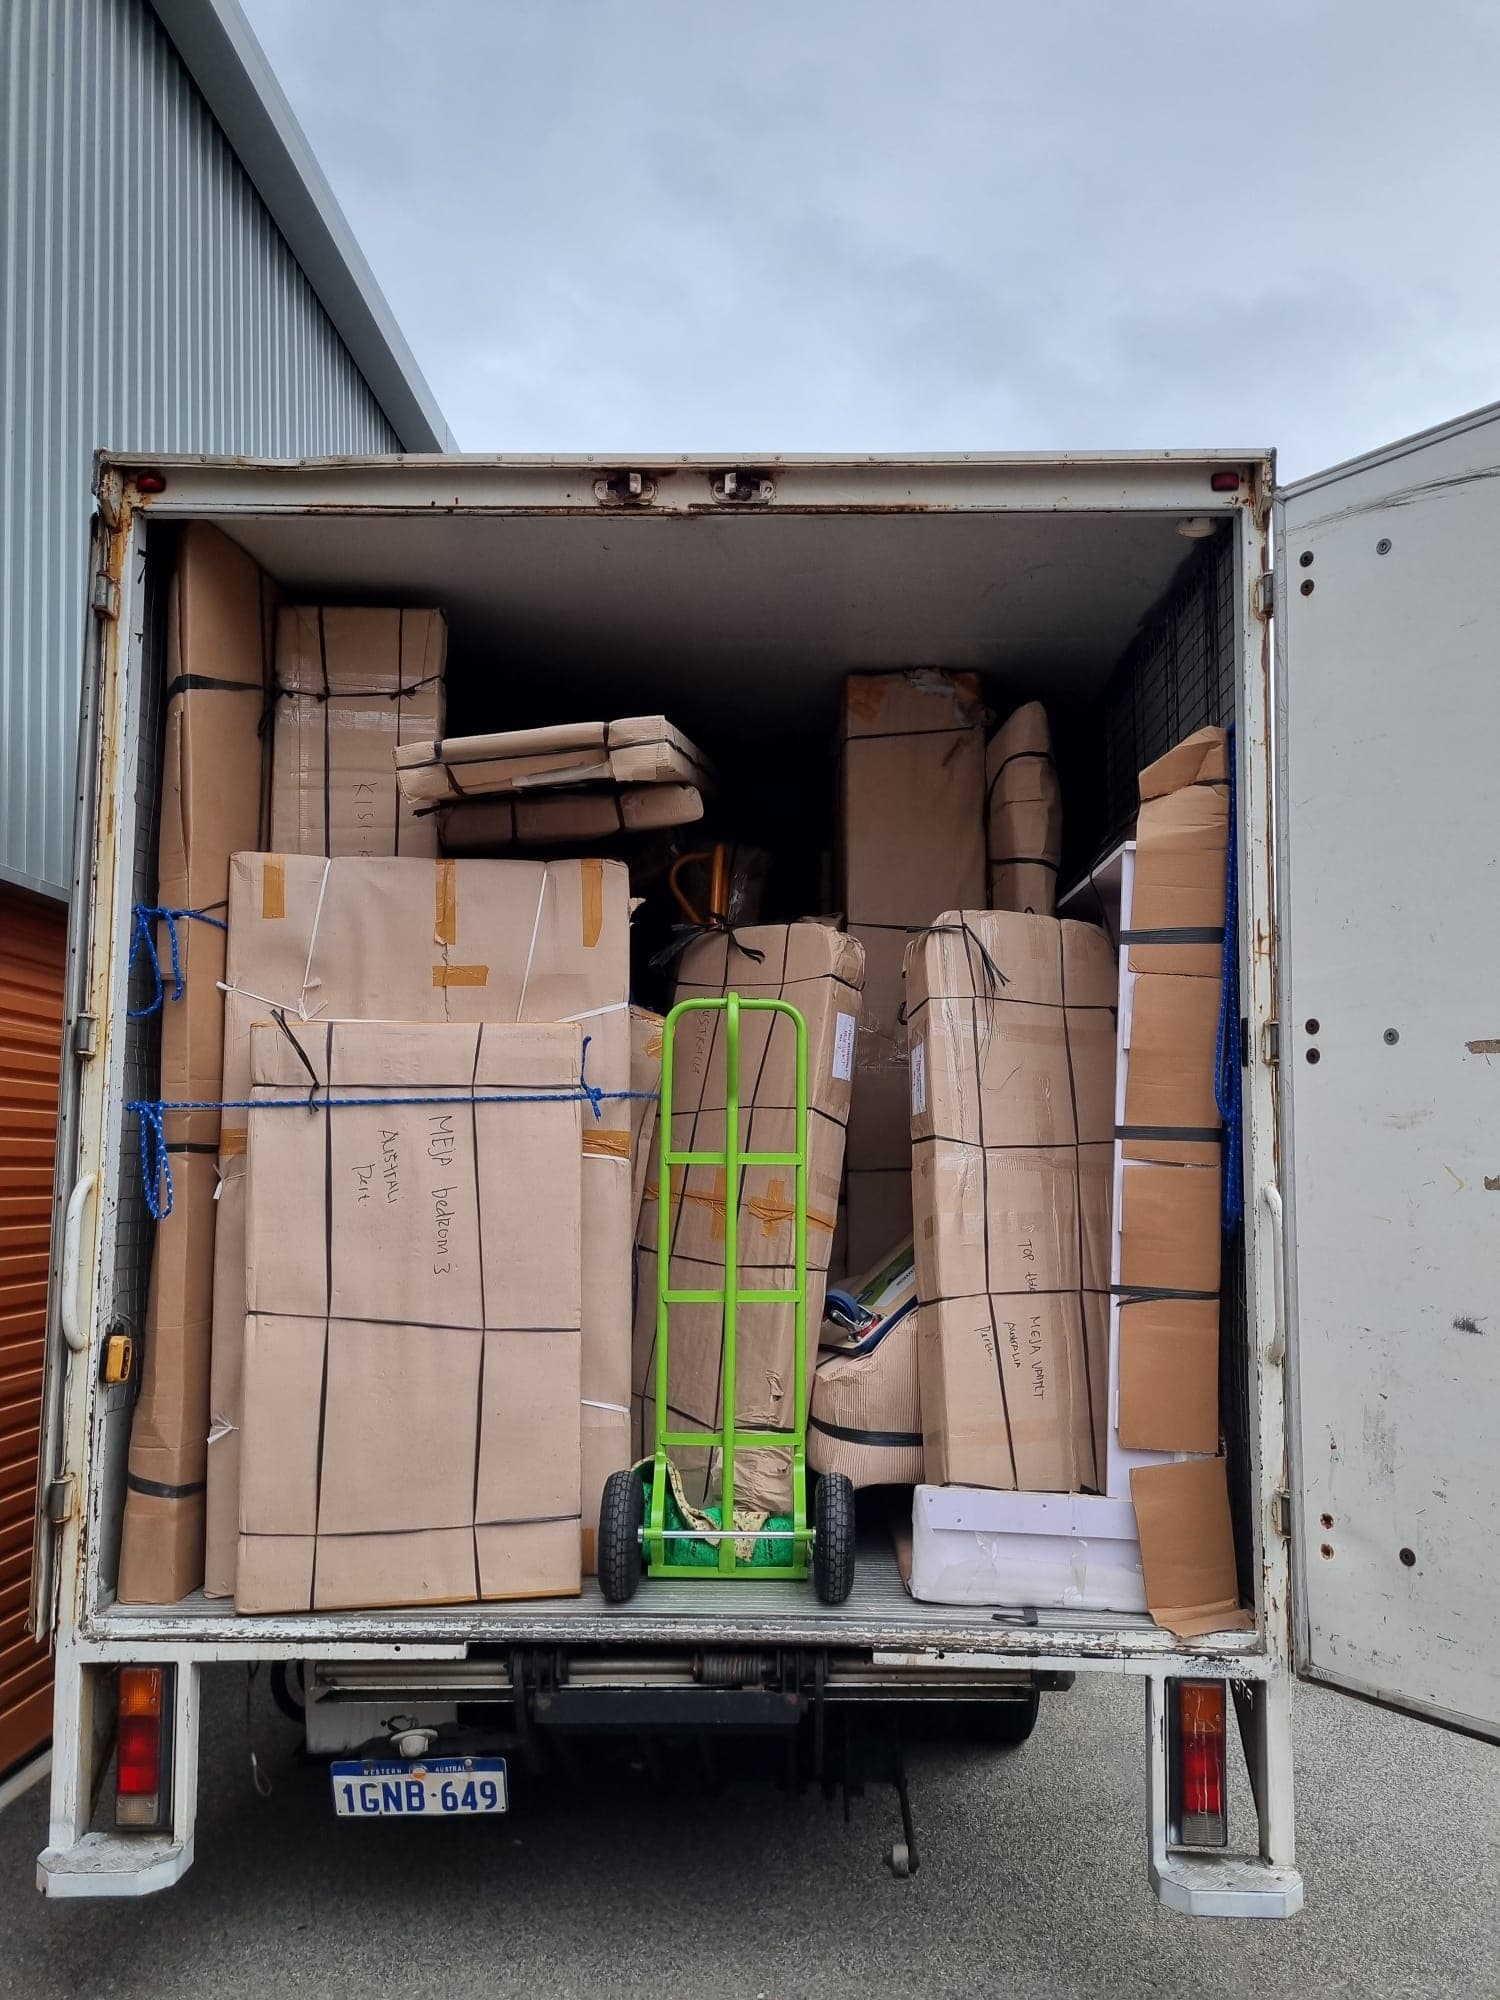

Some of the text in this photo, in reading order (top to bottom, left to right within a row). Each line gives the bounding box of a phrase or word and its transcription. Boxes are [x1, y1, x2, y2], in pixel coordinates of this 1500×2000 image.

[1017, 1239, 1035, 1261] TOP
[433, 1262, 451, 1275] 3
[1029, 1315, 1042, 1355] MEJA
[342, 1780, 498, 1813] 1GNB 649
